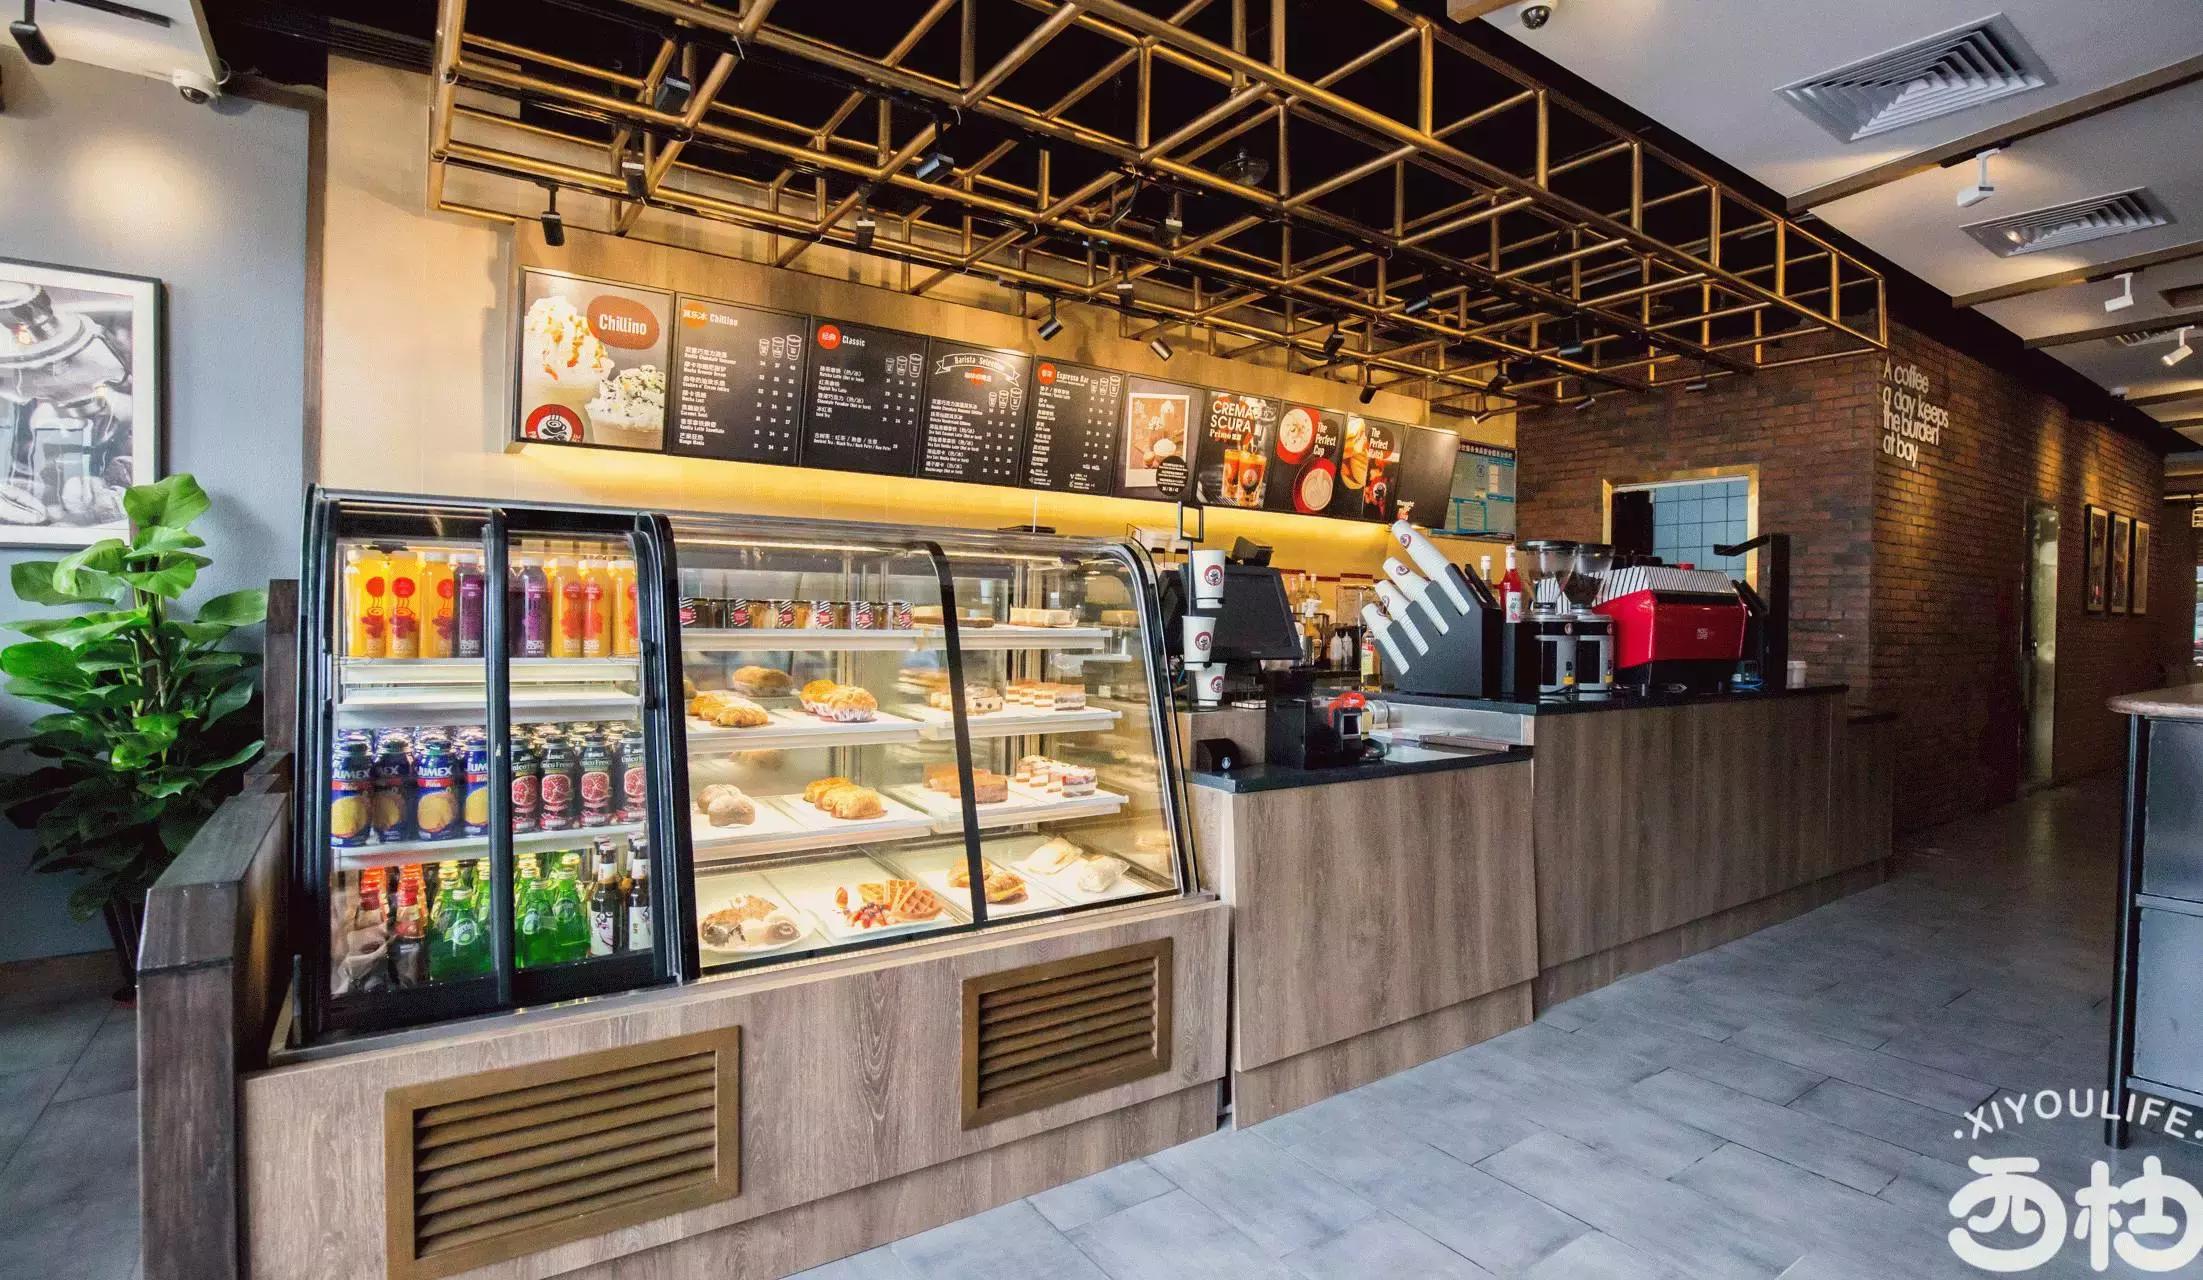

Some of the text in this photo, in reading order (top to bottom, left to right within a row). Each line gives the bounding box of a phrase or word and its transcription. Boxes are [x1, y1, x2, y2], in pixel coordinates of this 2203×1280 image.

[599, 313, 647, 336] Chillino
[709, 313, 738, 326] Chillino
[842, 335, 866, 347] Classic
[954, 355, 976, 365] Barista
[1056, 371, 1079, 383] Espresso
[1883, 357, 1929, 394] A coffee
[1213, 401, 1256, 419] CREMA
[1883, 386, 1949, 429] a day keeps
[1210, 416, 1252, 433] SCURA
[1317, 421, 1328, 433] The
[1883, 402, 1940, 446] the burden
[1209, 429, 1231, 440] Primo
[1371, 427, 1381, 438] The
[1315, 433, 1337, 446] Perfect
[1369, 438, 1389, 450] Perfect
[1313, 444, 1325, 458] Cup
[1883, 431, 1919, 468] at bay
[418, 765, 453, 777] JUMEX
